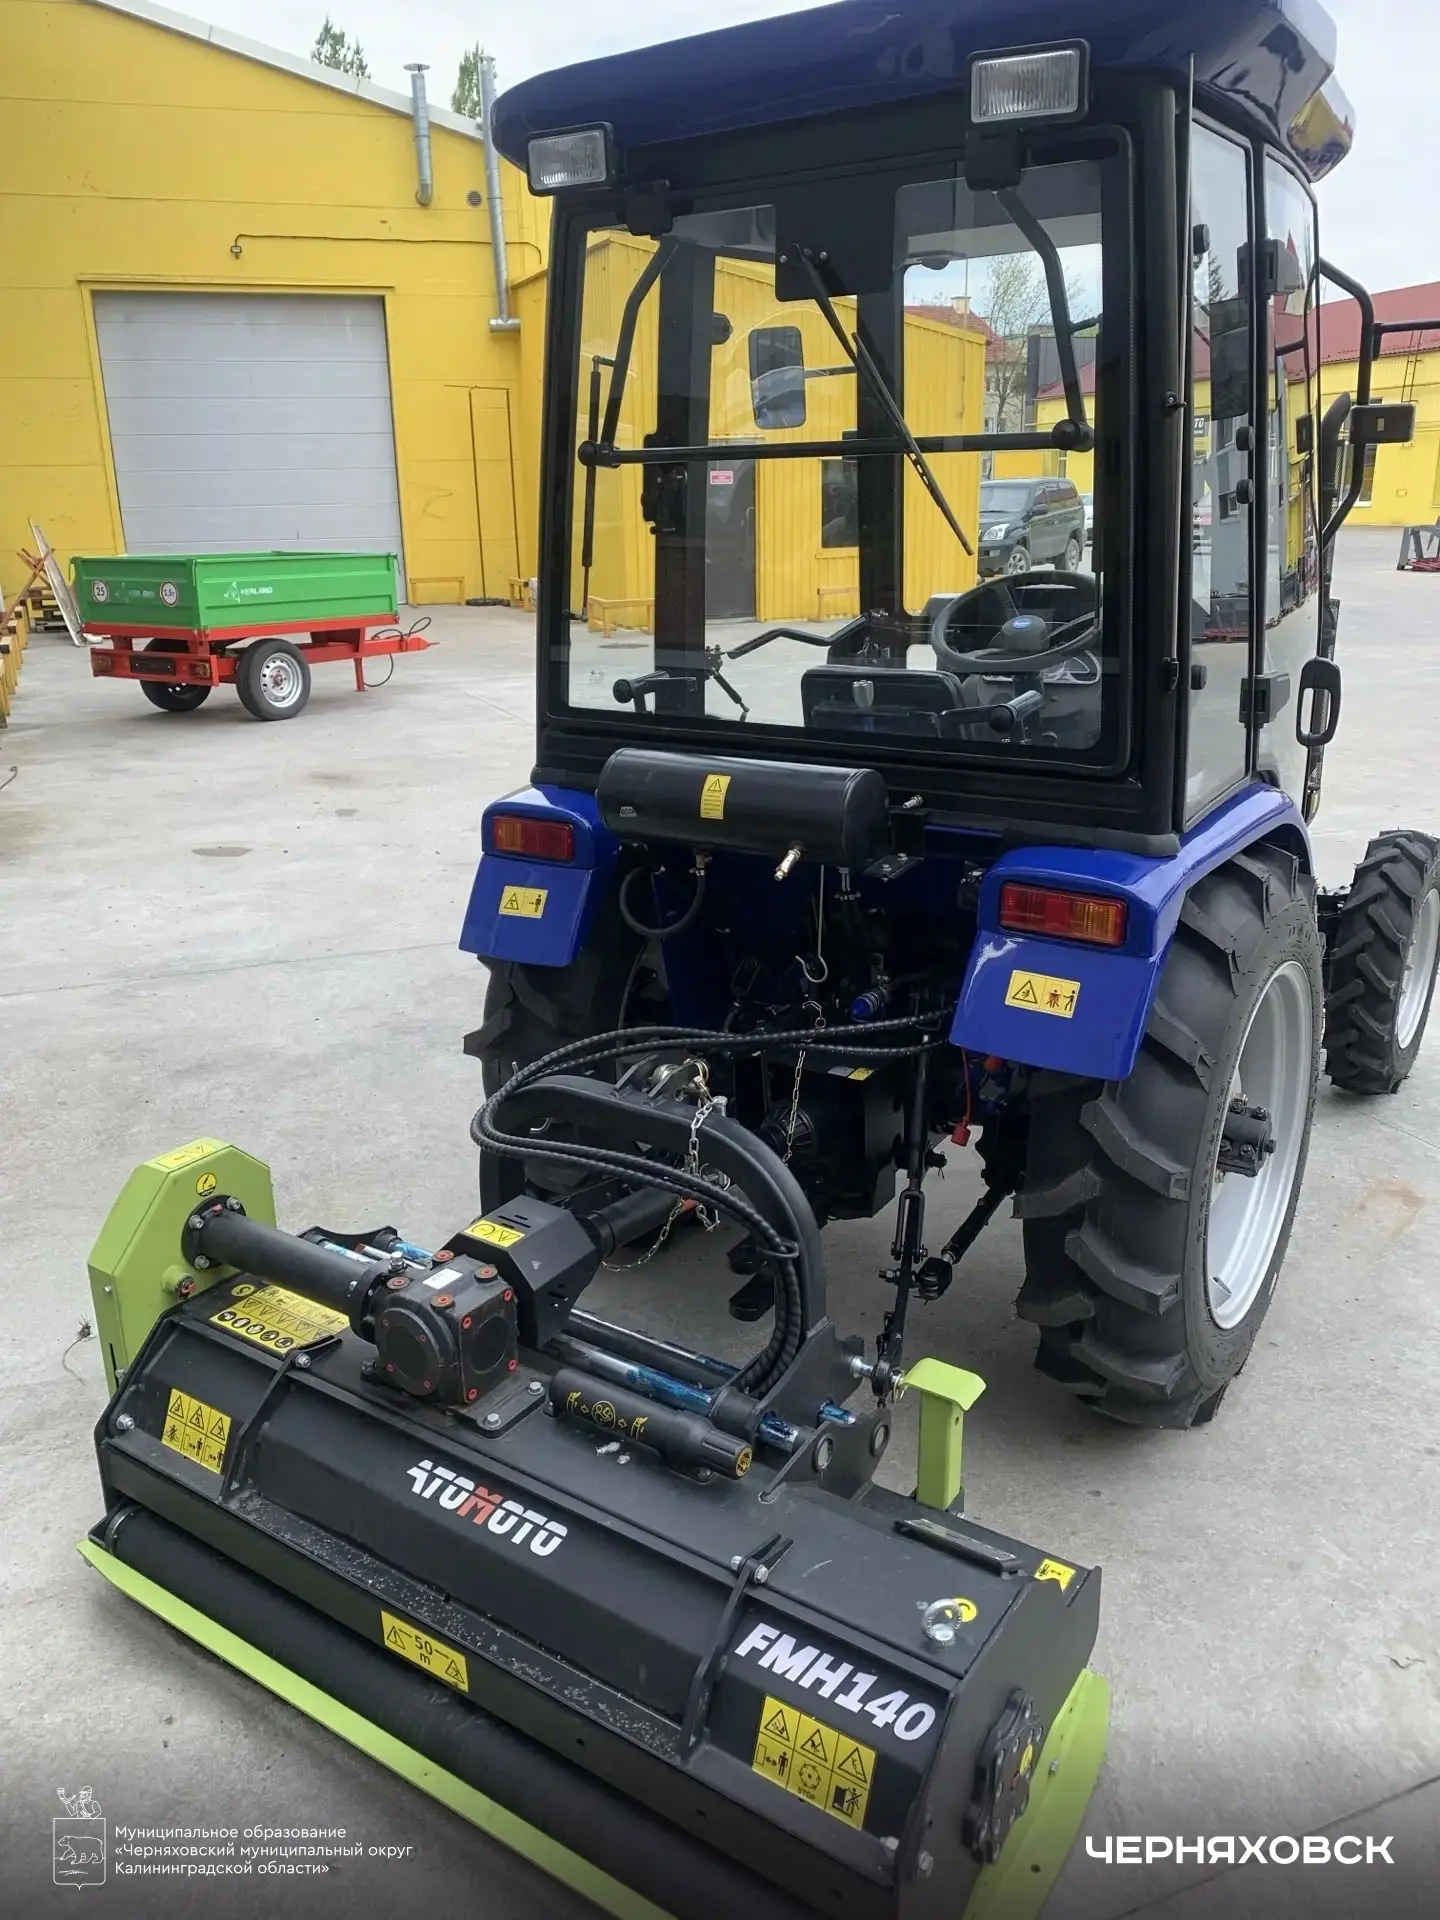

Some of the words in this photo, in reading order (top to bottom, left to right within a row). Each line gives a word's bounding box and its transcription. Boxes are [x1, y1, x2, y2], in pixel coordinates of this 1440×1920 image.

[95, 586, 106, 597] 25
[406, 1459, 568, 1556] ATOMOTO
[413, 1635, 433, 1656] 50
[419, 1651, 431, 1666] m
[734, 1622, 936, 1741] FMH140
[797, 1786, 816, 1800] STOP
